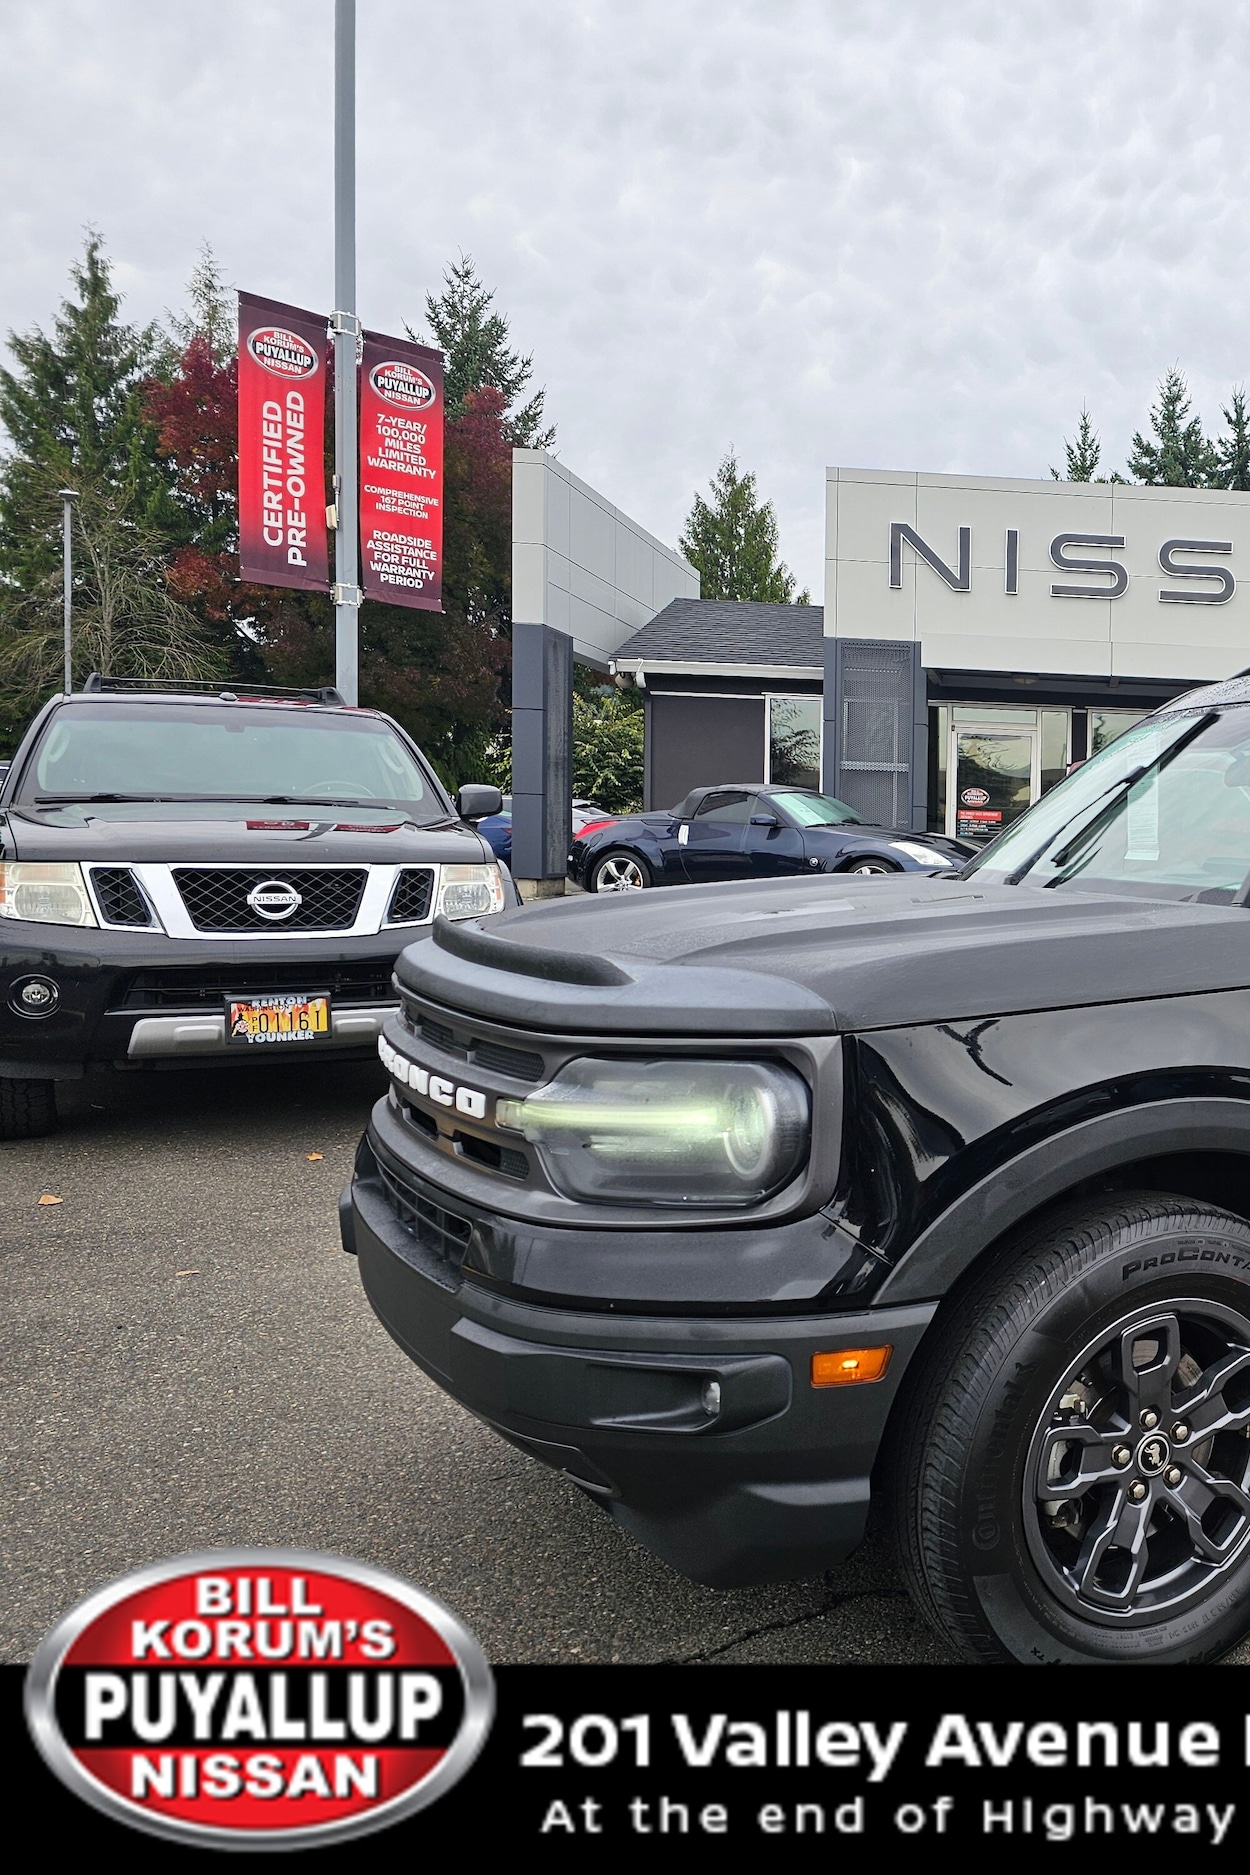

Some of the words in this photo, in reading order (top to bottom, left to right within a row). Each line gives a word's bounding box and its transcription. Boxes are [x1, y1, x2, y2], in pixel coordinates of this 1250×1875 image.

[263, 335, 305, 353] KORUM'S
[273, 331, 294, 343] BILL
[255, 341, 312, 368] PUYALLUP
[263, 357, 302, 374] NISSAN
[394, 365, 413, 376] BILL
[384, 369, 423, 385] KORUM'S
[377, 376, 430, 399] PUYALLUP
[384, 389, 421, 405] NISSAN
[376, 413, 427, 434] 7-YEAR/
[376, 424, 426, 444] 100,000
[385, 437, 421, 454] MILES
[378, 447, 426, 467] LIMITED
[262, 400, 283, 547] CERTIFIED
[367, 455, 436, 480] WARRANTY
[286, 391, 307, 567] PRE-OWNED
[364, 485, 439, 506] COMPREHENSIVE
[380, 496, 396, 505] 167
[397, 498, 425, 511] POINT
[376, 502, 428, 519] INSPECTION
[373, 530, 432, 549] ROADSIDE
[367, 540, 437, 561] ASSISTANCE
[374, 551, 400, 564] FOR
[401, 556, 429, 570] FULL
[370, 561, 435, 581] WARRANTY
[380, 573, 423, 589] PERIOD
[253, 895, 297, 903] NISSAN
[259, 1010, 320, 1033] 01161
[246, 1030, 314, 1044] YOUNKER
